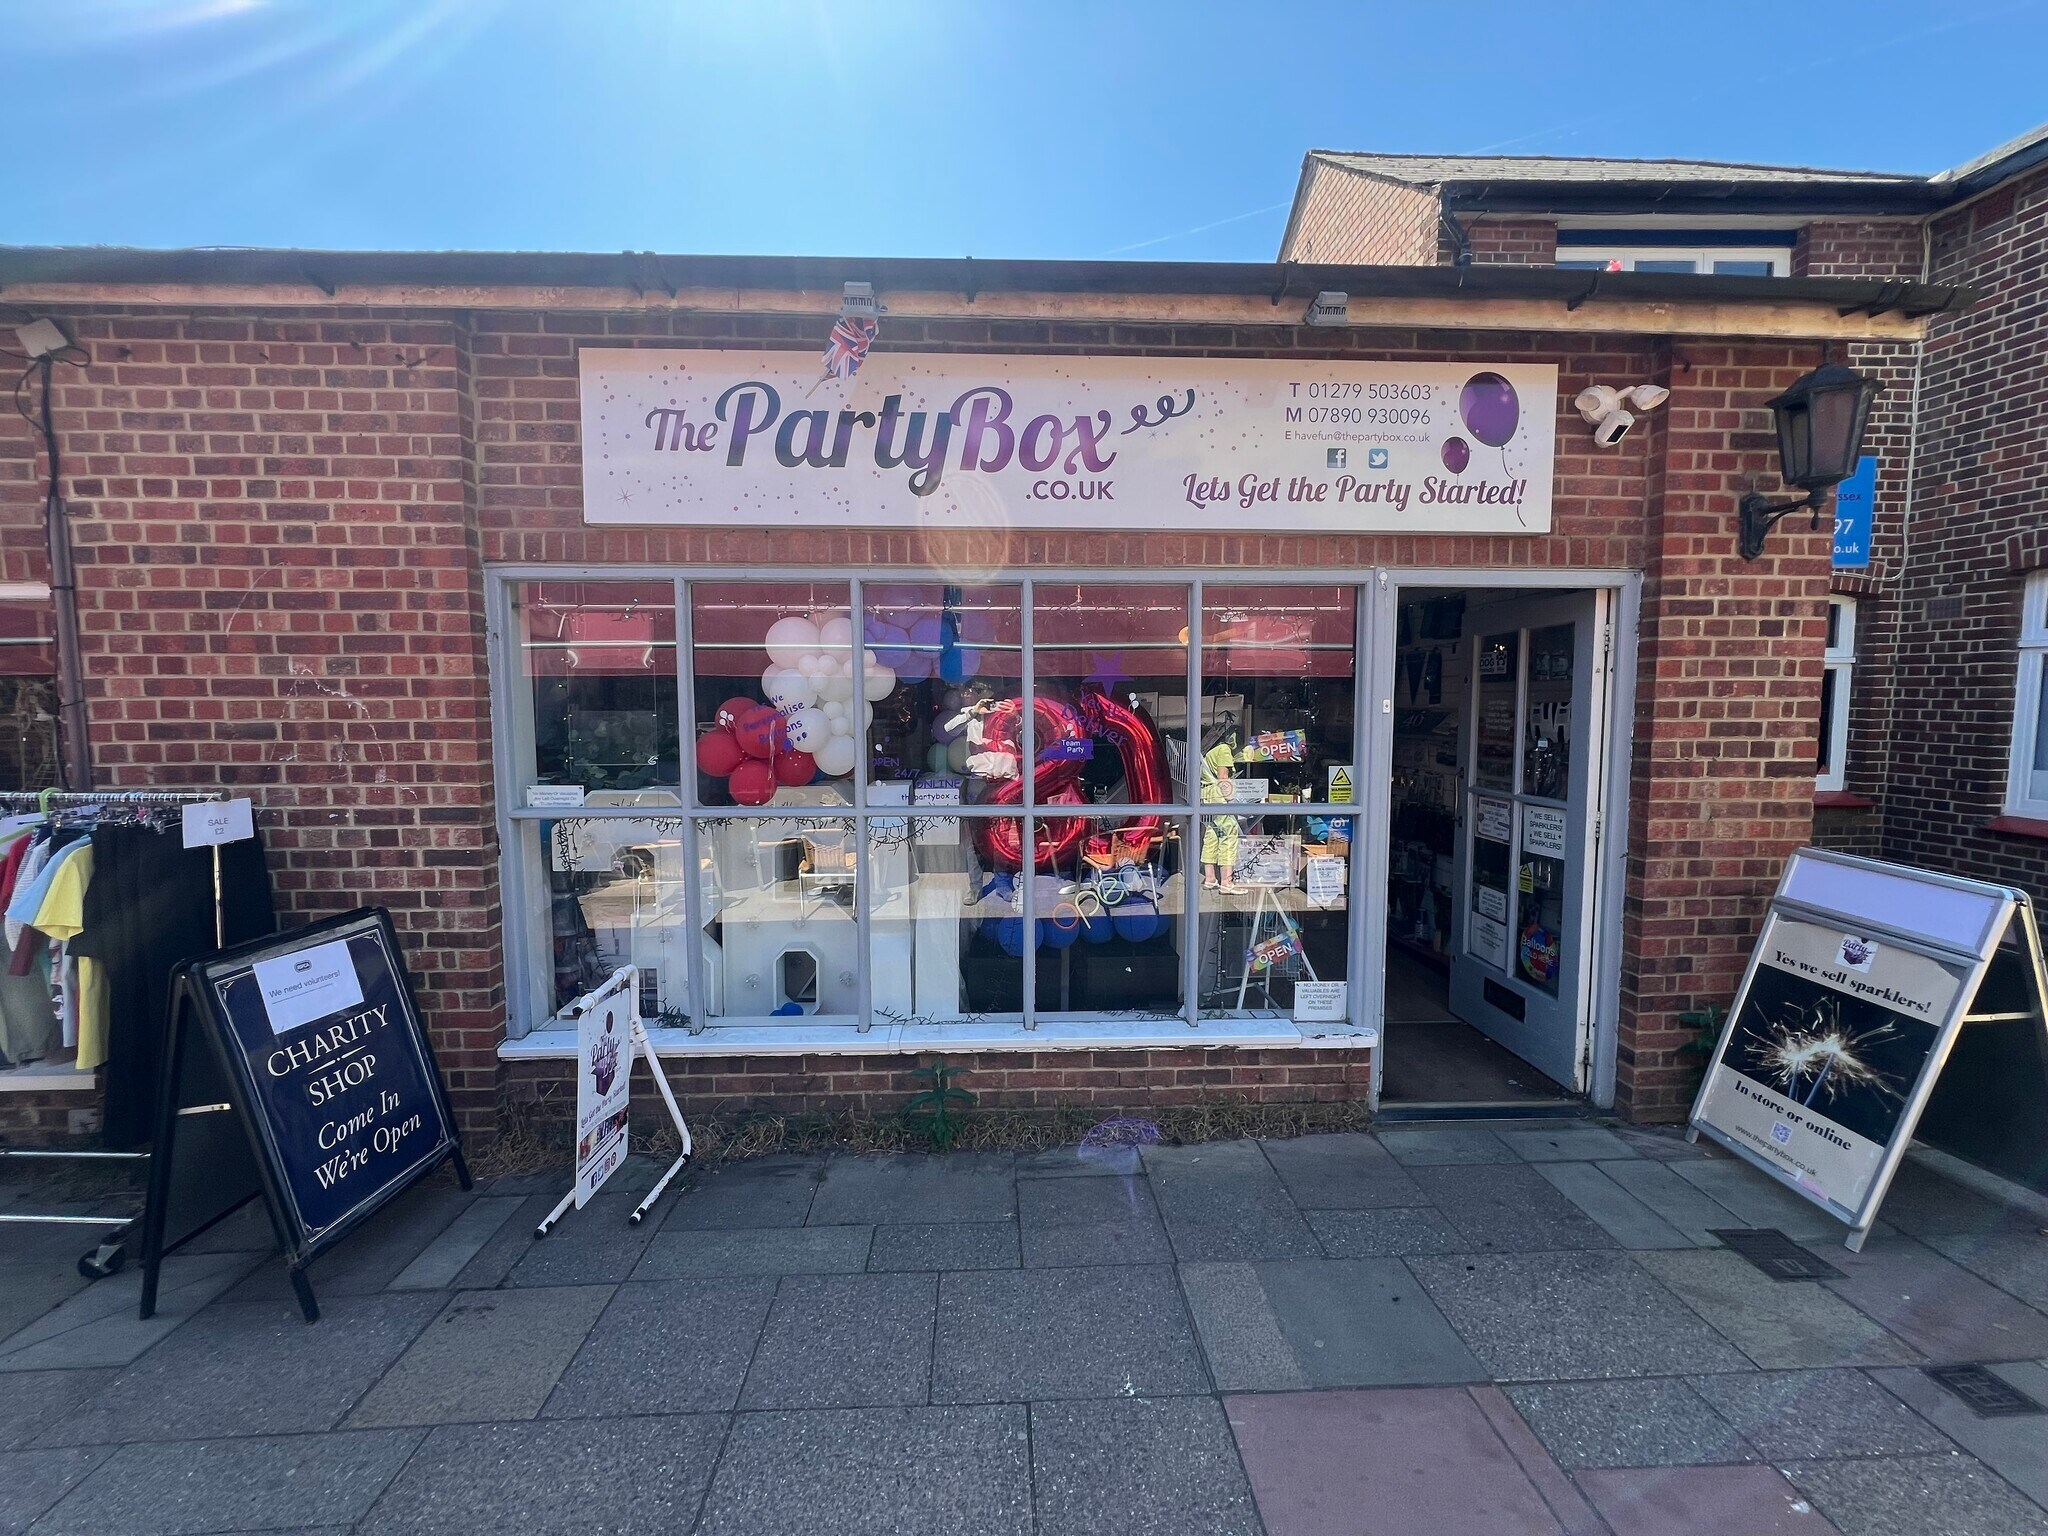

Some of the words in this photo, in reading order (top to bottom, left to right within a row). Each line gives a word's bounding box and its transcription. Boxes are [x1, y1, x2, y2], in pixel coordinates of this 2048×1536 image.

[1289, 382, 1301, 398] T
[1308, 382, 1363, 399] 01279
[1368, 384, 1431, 400] 503603
[1285, 407, 1302, 423] M
[1308, 407, 1362, 424] 07890
[1367, 408, 1431, 425] 930096
[645, 407, 718, 452] The
[1285, 430, 1292, 440] E
[1294, 430, 1430, 444] havefun@thepartybox.co.uk
[1025, 480, 1115, 501] .CO.UK
[1182, 473, 1231, 510] Lets
[1237, 473, 1281, 509] Get
[1287, 476, 1329, 502] the
[1335, 474, 1412, 512] Party
[1418, 475, 1527, 506] Started!
[1061, 739, 1081, 747] Team
[1066, 746, 1085, 754] Party
[1259, 741, 1297, 757] OPEN
[872, 757, 900, 767] OPEN
[894, 768, 920, 778] 24/7
[916, 780, 961, 789] ONLINE
[207, 817, 229, 827] SALE
[1529, 820, 1564, 832] SPARKLERS!
[1543, 814, 1558, 822] SELL
[214, 827, 225, 835] £2
[1543, 832, 1558, 841] SELL
[1258, 942, 1294, 964] OPEN
[1521, 935, 1555, 957] Balloons
[269, 989, 282, 998] We
[283, 982, 303, 994] need
[303, 969, 341, 988] volunteers!
[1775, 950, 1796, 967] Yes
[1799, 962, 1818, 975] we
[1820, 970, 1848, 985] sell
[1849, 980, 1932, 1014] sparklers!
[267, 1003, 390, 1077] CHARITY
[308, 1054, 377, 1107] SHOP
[318, 1107, 374, 1150] Come
[379, 1090, 401, 1116] In
[1734, 1080, 1749, 1096] In
[1750, 1091, 1785, 1114] store
[1786, 1111, 1803, 1124] or
[1805, 1120, 1852, 1151] online
[313, 1149, 369, 1190] We're
[373, 1114, 422, 1154] Open
[1735, 1124, 1818, 1177] www.thepartybox.co.uk
